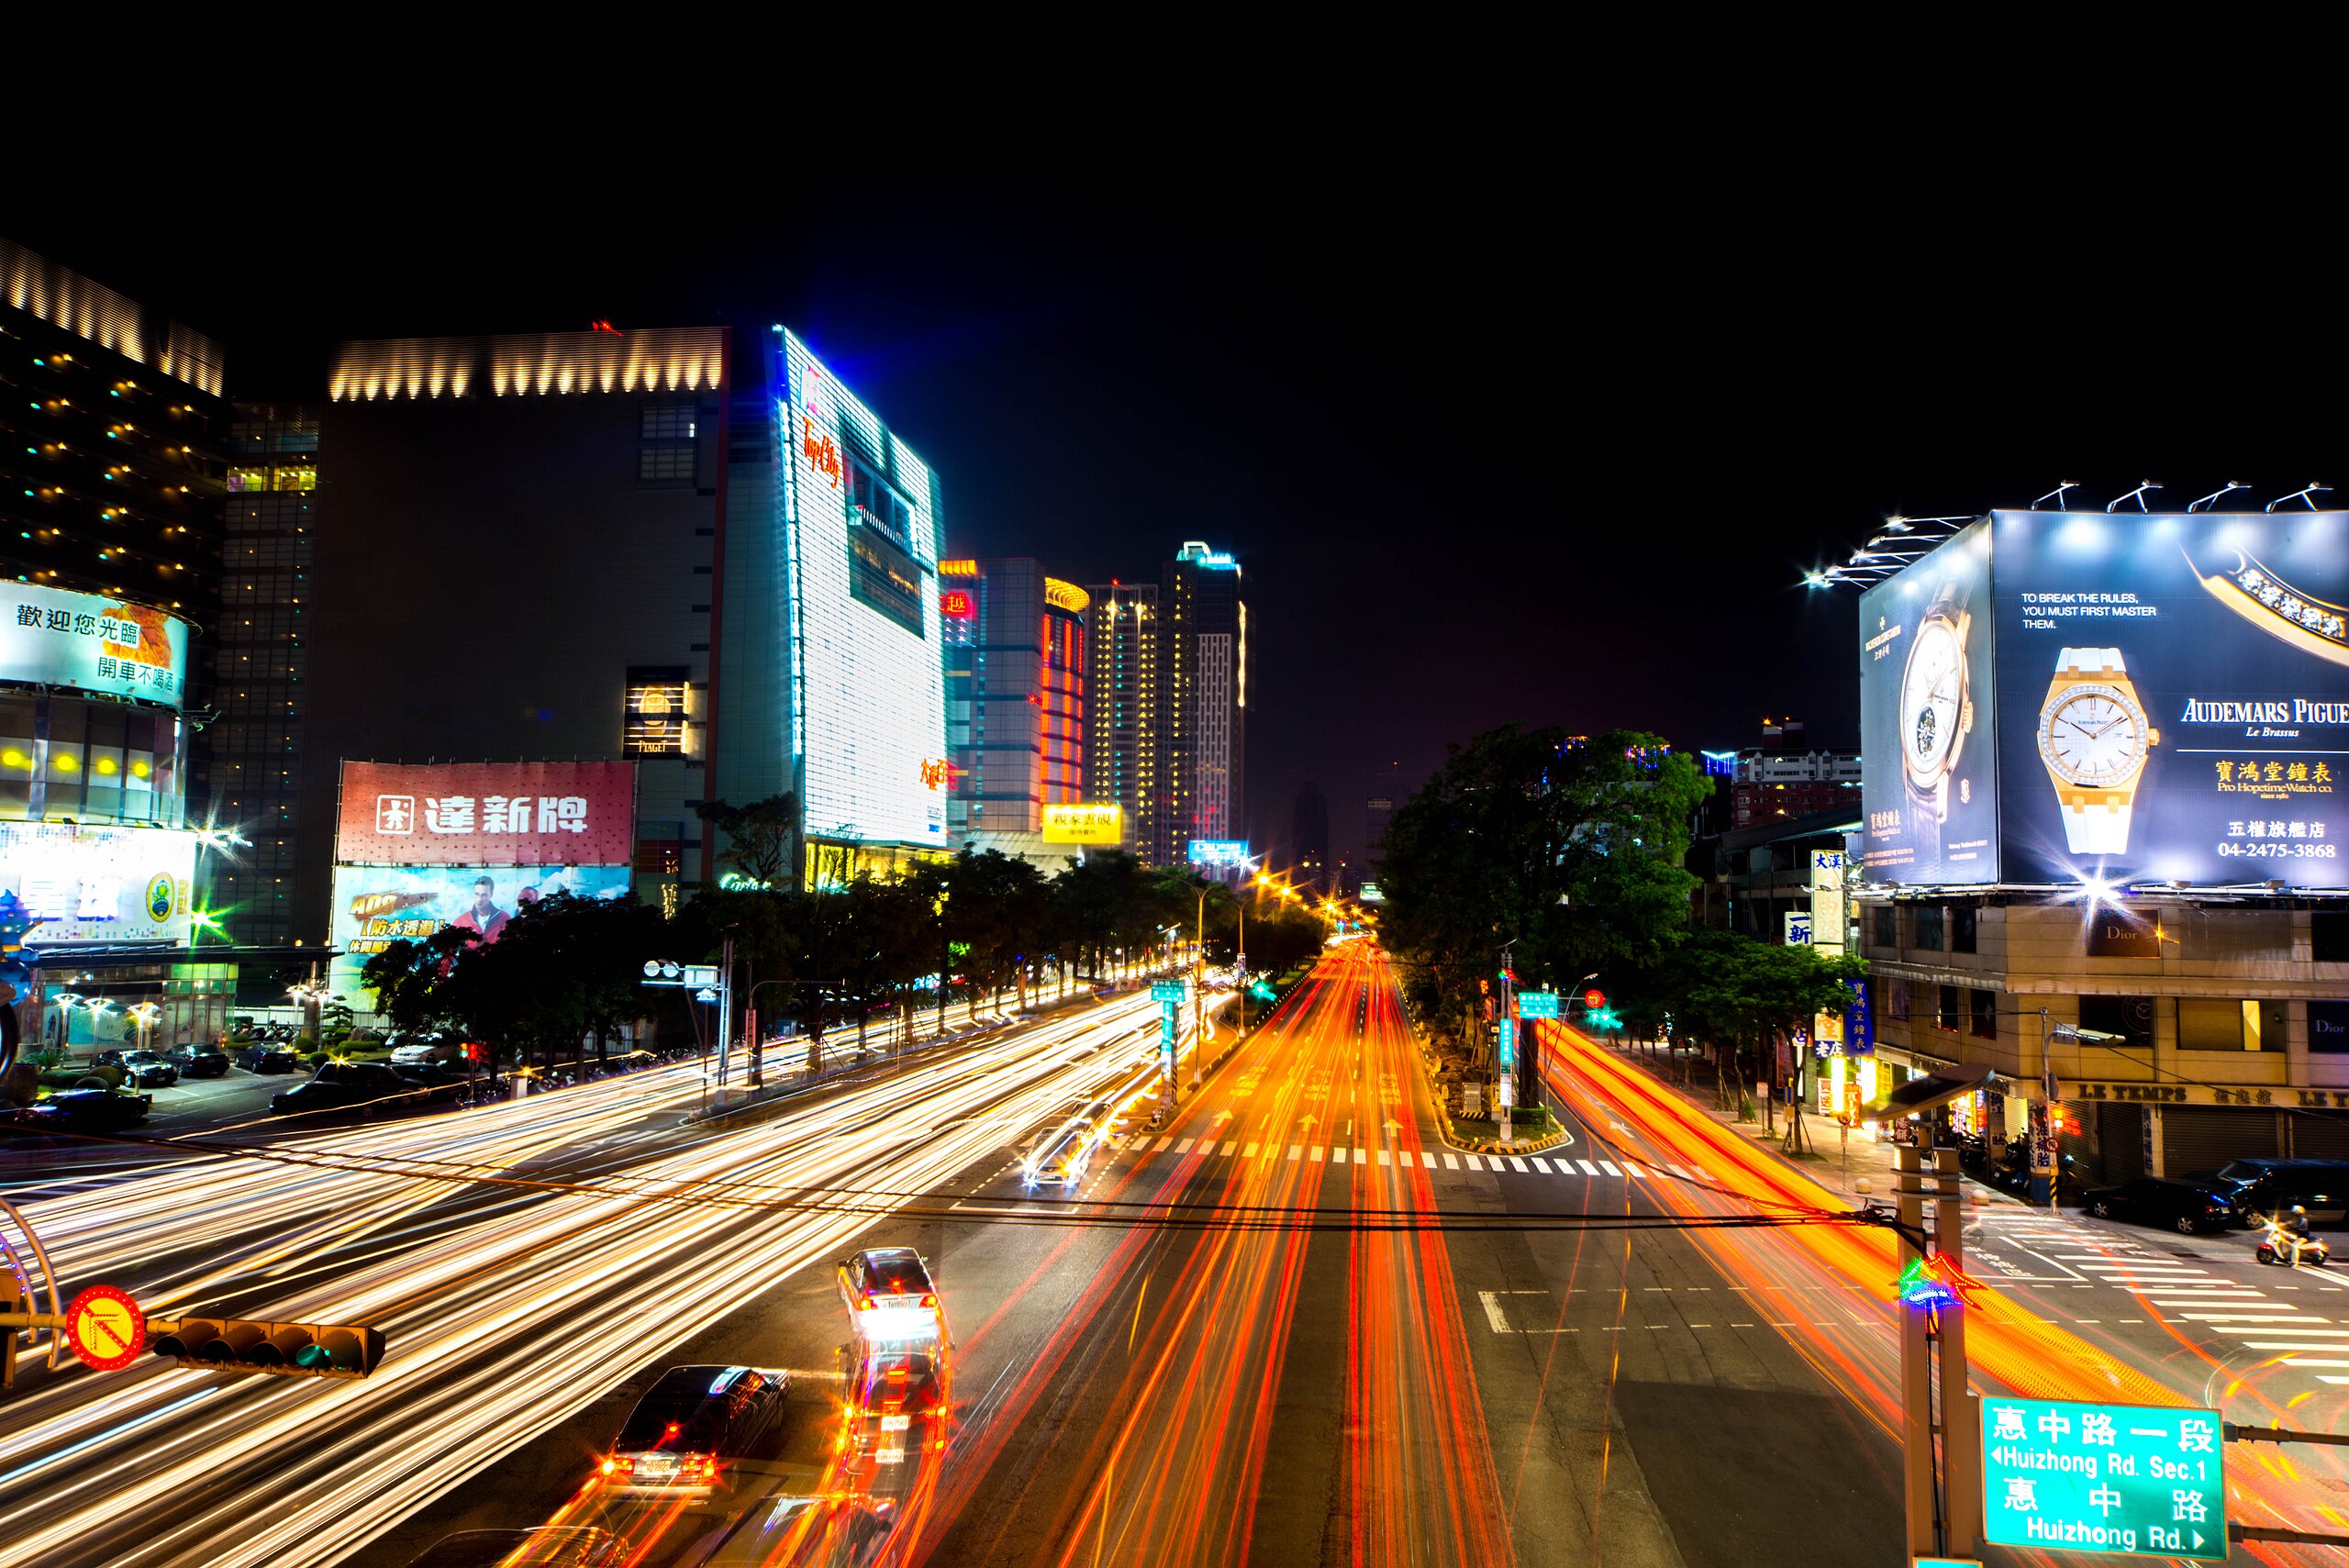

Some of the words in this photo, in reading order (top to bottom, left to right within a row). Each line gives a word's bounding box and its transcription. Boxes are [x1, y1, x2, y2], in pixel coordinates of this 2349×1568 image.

[2021, 593, 2037, 603] TO
[2039, 593, 2076, 603] BREAK
[2076, 593, 2099, 603] THE
[2100, 594, 2139, 604] RULES,
[2022, 606, 2046, 617] YOU
[2048, 606, 2078, 617] MUST
[2080, 606, 2110, 617] FIRST
[2111, 606, 2157, 617] MASTER
[17, 603, 139, 645] 歡迎您光臨
[2022, 619, 2056, 629] THEM.
[2180, 698, 2289, 723] AUDEMARS
[2245, 727, 2259, 737] Le
[2262, 727, 2299, 738] Brassus
[639, 740, 667, 752] PIAGET
[2215, 760, 2332, 784] 寶鴻堂鐘表
[2218, 782, 2236, 792] Pro
[425, 795, 588, 834] 達新牌
[2227, 820, 2326, 839] 五權旗艦店
[2218, 842, 2336, 858] 04-2475-3868
[1815, 853, 1842, 869] 大漢
[2106, 926, 2139, 940] Dior
[1854, 983, 1865, 1049] 寶鴻堂鐘表
[2315, 1019, 2345, 1033] Dior
[1815, 1040, 1843, 1057] 老店
[2078, 1084, 2107, 1099] LE
[2112, 1085, 2188, 1102] TEMPS
[2298, 1090, 2328, 1106] LE
[1992, 1406, 2214, 1453] 惠中路一段
[2004, 1445, 2098, 1479] Huizhong
[2108, 1453, 2140, 1476] Rd.
[2150, 1455, 2206, 1481] Sec.1
[2004, 1475, 2209, 1523] 惠中路
[2027, 1516, 2136, 1552] Huizhong
[2149, 1526, 2187, 1551] Rd.
